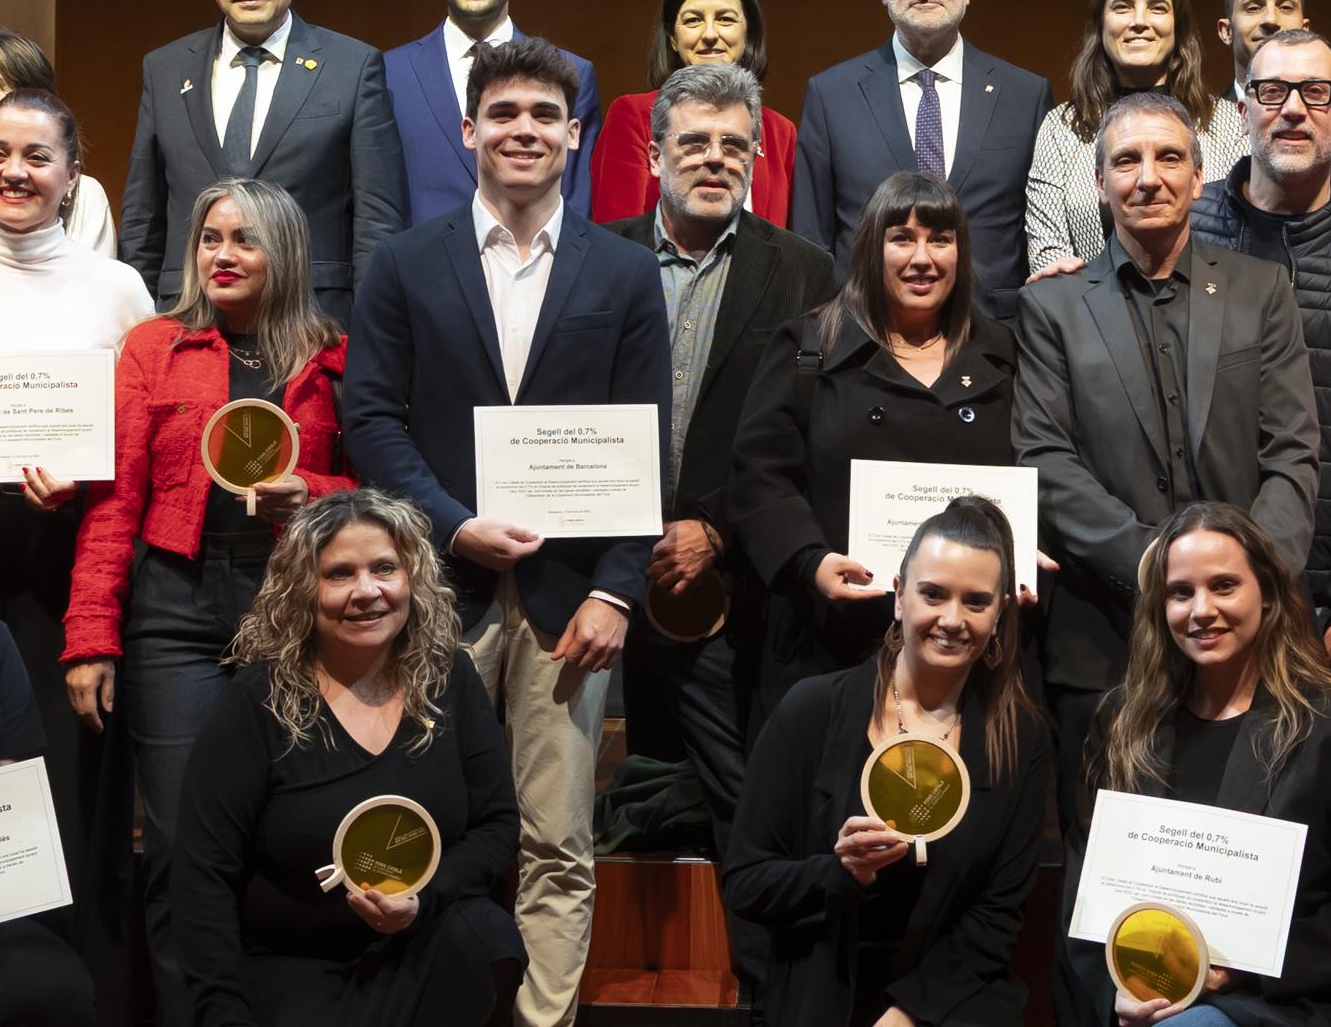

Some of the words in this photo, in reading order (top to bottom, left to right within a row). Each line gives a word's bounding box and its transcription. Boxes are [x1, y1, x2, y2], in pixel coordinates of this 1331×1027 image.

[15, 372, 28, 380] del
[22, 380, 78, 390] Municipalista
[536, 428, 562, 437] Segell
[522, 437, 569, 446] Cooperació
[571, 436, 625, 445] Municipalista
[912, 484, 938, 494] Segell
[939, 486, 953, 494] del
[885, 492, 896, 500] de
[1159, 824, 1188, 837] Segell
[1189, 830, 1204, 840] del
[1206, 832, 1229, 845] 0,7%
[1127, 831, 1139, 840] de
[1141, 832, 1194, 849] Cooperació
[1196, 842, 1259, 861] Municipalista
[1151, 865, 1192, 878] Ajuntament
[1193, 873, 1203, 881] de
